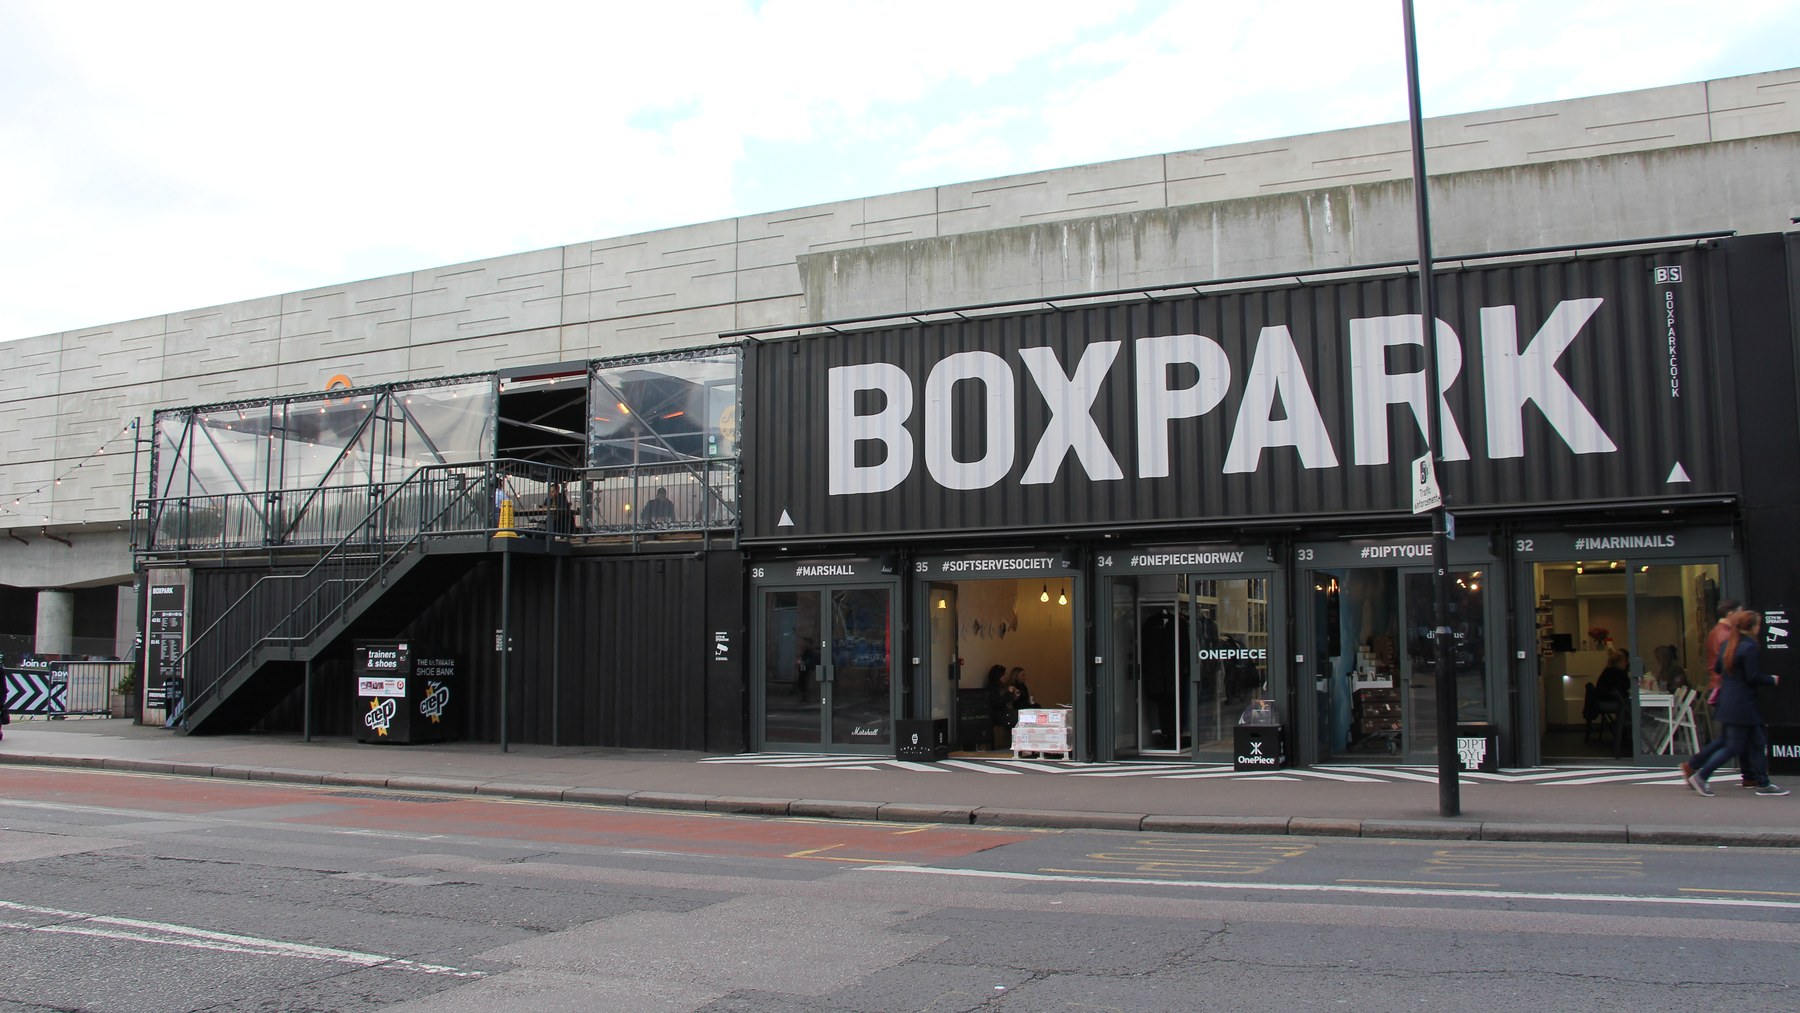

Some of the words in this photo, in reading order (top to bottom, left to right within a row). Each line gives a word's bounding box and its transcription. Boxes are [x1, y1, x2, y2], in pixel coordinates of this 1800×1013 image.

[1655, 266, 1682, 284] BS
[828, 297, 1618, 495] BOXPARK
[1516, 539, 1534, 551] 32
[1575, 535, 1675, 550] #IMARNINAILS
[1298, 549, 1314, 560] 33
[1360, 544, 1433, 559] #DIPTYQUE
[1097, 556, 1113, 567] 34
[1130, 551, 1244, 567] #ONEPIECENORWAY
[796, 564, 855, 576] #MARSHALL
[915, 562, 928, 572] 35
[942, 558, 1054, 572] #SOFTSERVESOCIETY
[752, 568, 765, 578] 36
[1438, 568, 1444, 576] 5
[368, 650, 396, 659] trainers
[1199, 649, 1267, 660] ONEPIECE
[21, 659, 39, 668] Join
[367, 660, 374, 668] &
[375, 659, 397, 668] shoes
[416, 668, 434, 676] SHOE
[436, 668, 455, 676] BANK
[365, 699, 396, 729] crep
[851, 726, 878, 736] Marshall
[1238, 756, 1275, 764] OnePiece
